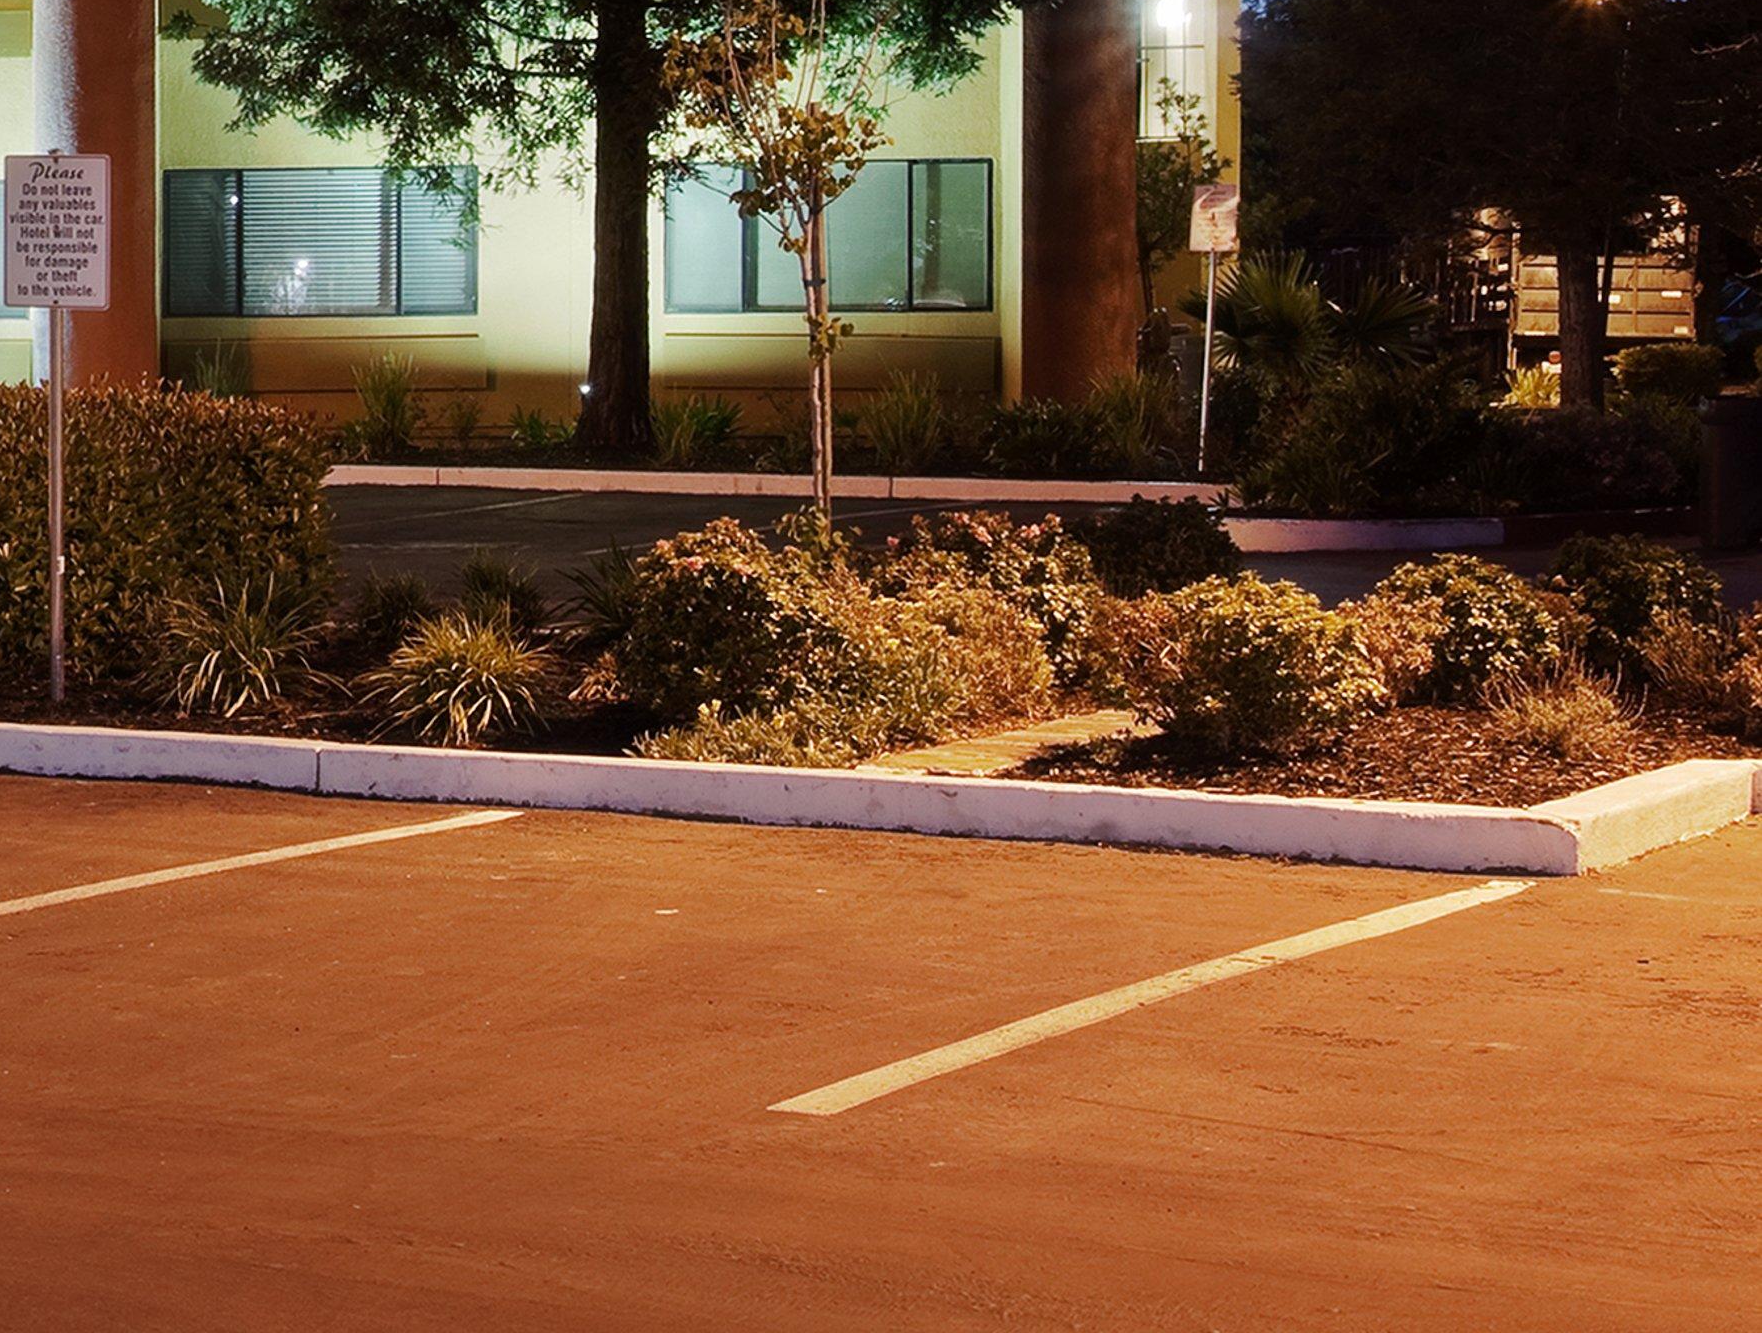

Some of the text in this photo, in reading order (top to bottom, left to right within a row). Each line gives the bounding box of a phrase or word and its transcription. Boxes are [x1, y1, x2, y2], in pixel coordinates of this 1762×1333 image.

[28, 161, 84, 183] Please
[22, 183, 92, 196] Do not leave
[18, 197, 96, 212] any valuables
[9, 213, 46, 224] visible
[49, 213, 60, 224] in
[63, 213, 81, 224] the
[19, 226, 94, 240] Hotel will not
[16, 240, 98, 255] be responsible
[25, 255, 89, 270] for damage
[36, 270, 78, 282] or theft
[17, 284, 29, 296] to
[31, 284, 49, 296] the
